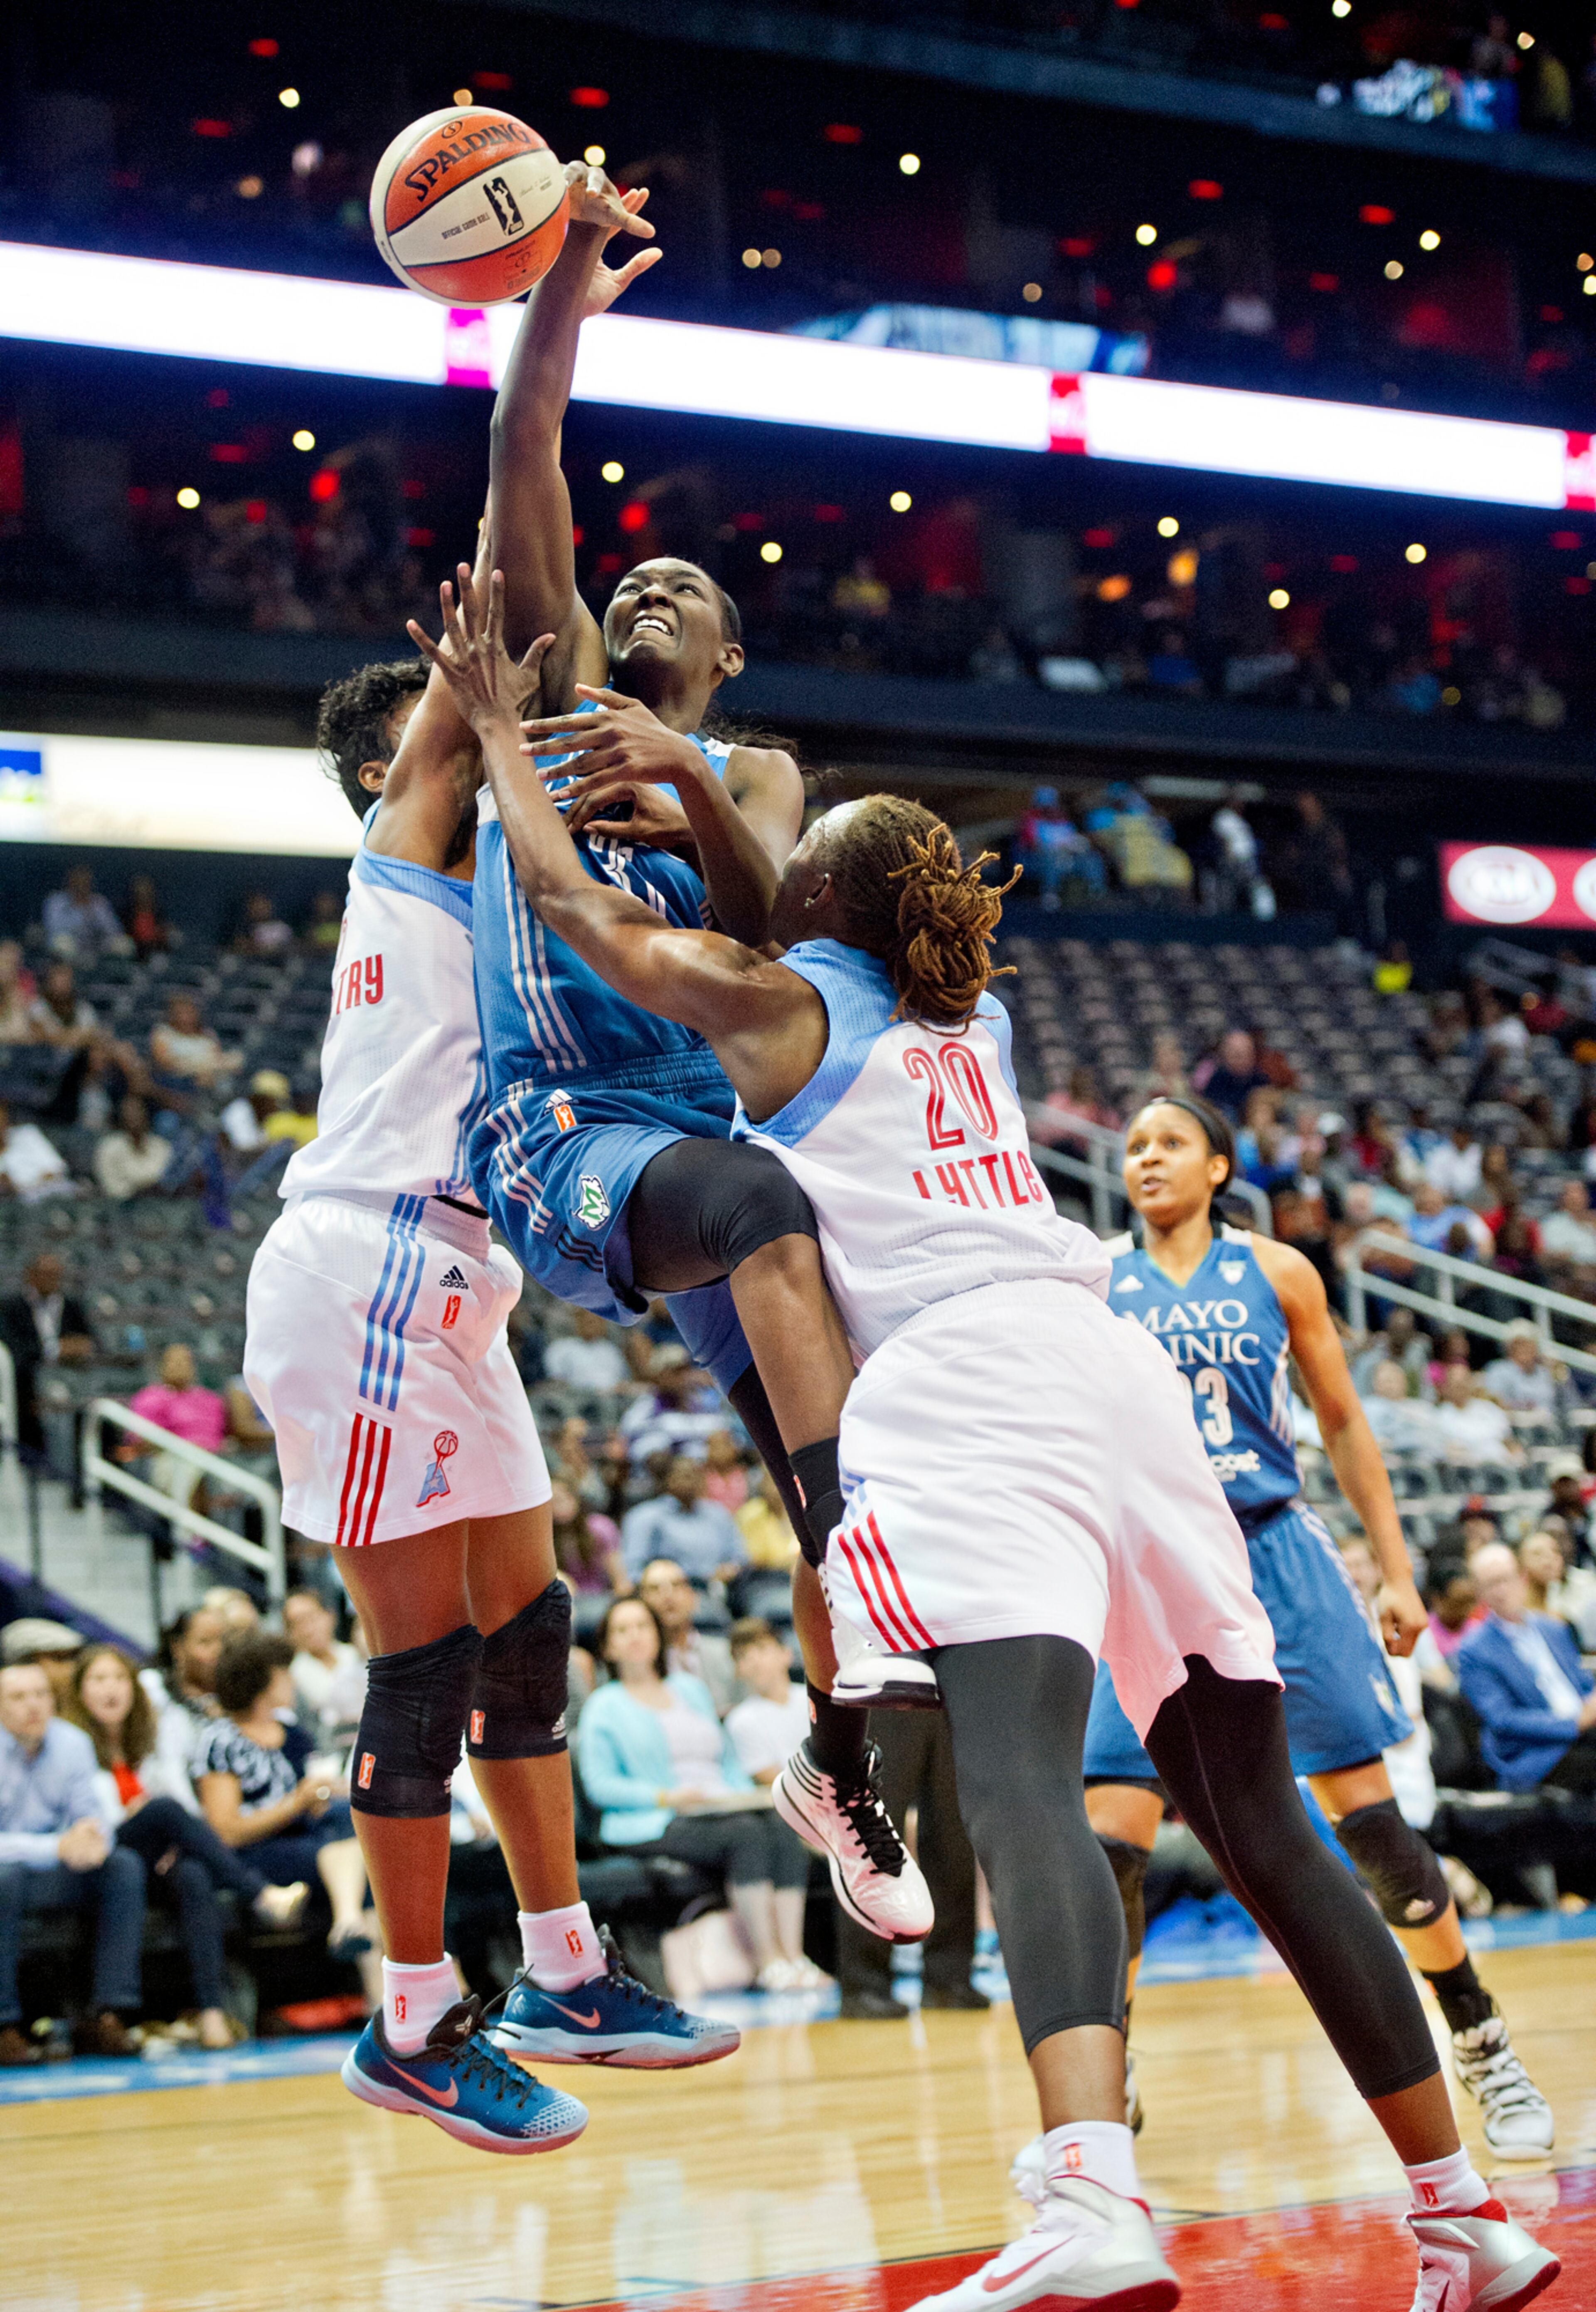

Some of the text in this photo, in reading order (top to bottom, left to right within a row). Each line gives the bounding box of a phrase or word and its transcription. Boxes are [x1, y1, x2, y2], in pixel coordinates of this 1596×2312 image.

[404, 122, 531, 202] SPALDING
[441, 226, 462, 239] OFFICIAL
[902, 1041, 999, 1151] 20
[439, 1279, 469, 1290] adidas
[1123, 1299, 1249, 1334] MAYO
[1166, 1331, 1260, 1366] INIC
[1210, 1449, 1261, 1472] oost
